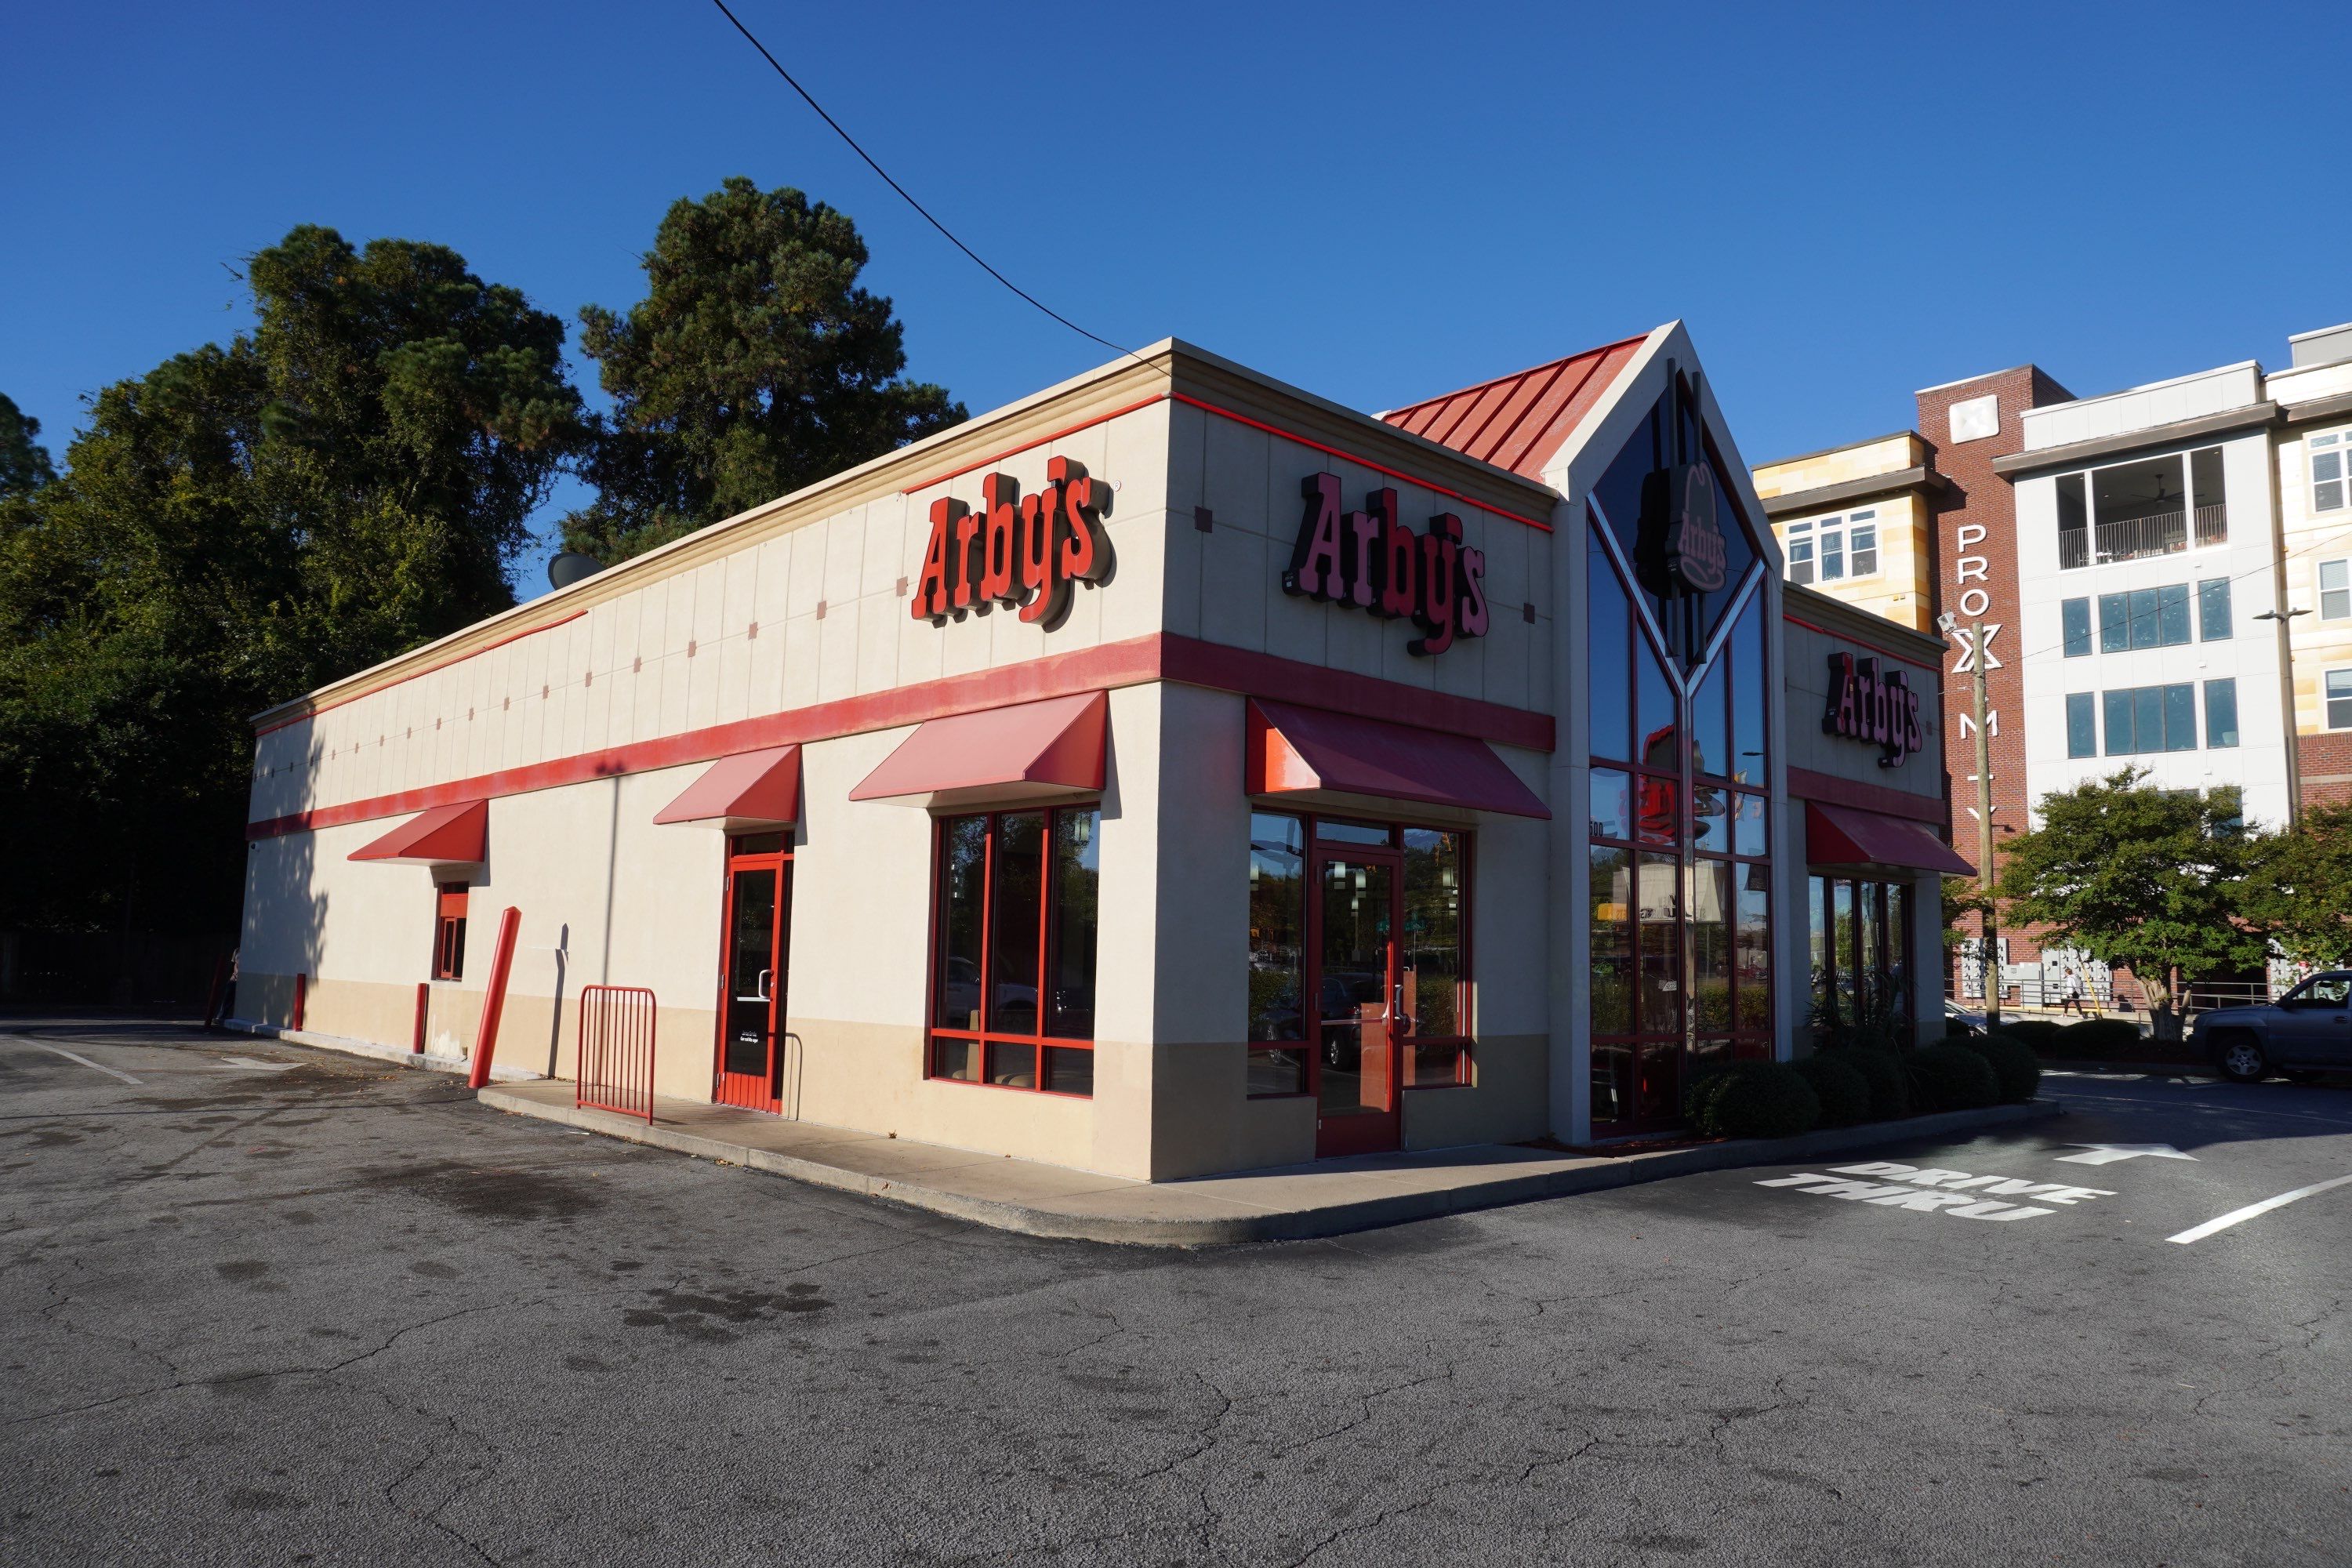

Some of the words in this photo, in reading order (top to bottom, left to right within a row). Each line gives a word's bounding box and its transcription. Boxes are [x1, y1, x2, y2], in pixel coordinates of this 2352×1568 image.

[911, 455, 1096, 623] Arby's
[1297, 471, 1490, 655] Arby's
[1678, 511, 1727, 575] Arby's
[1835, 652, 1922, 768] Arby's
[1951, 524, 2004, 825] PROXM
[1752, 1173, 2057, 1221] THRU
[1825, 1162, 2118, 1205] DRIVE
